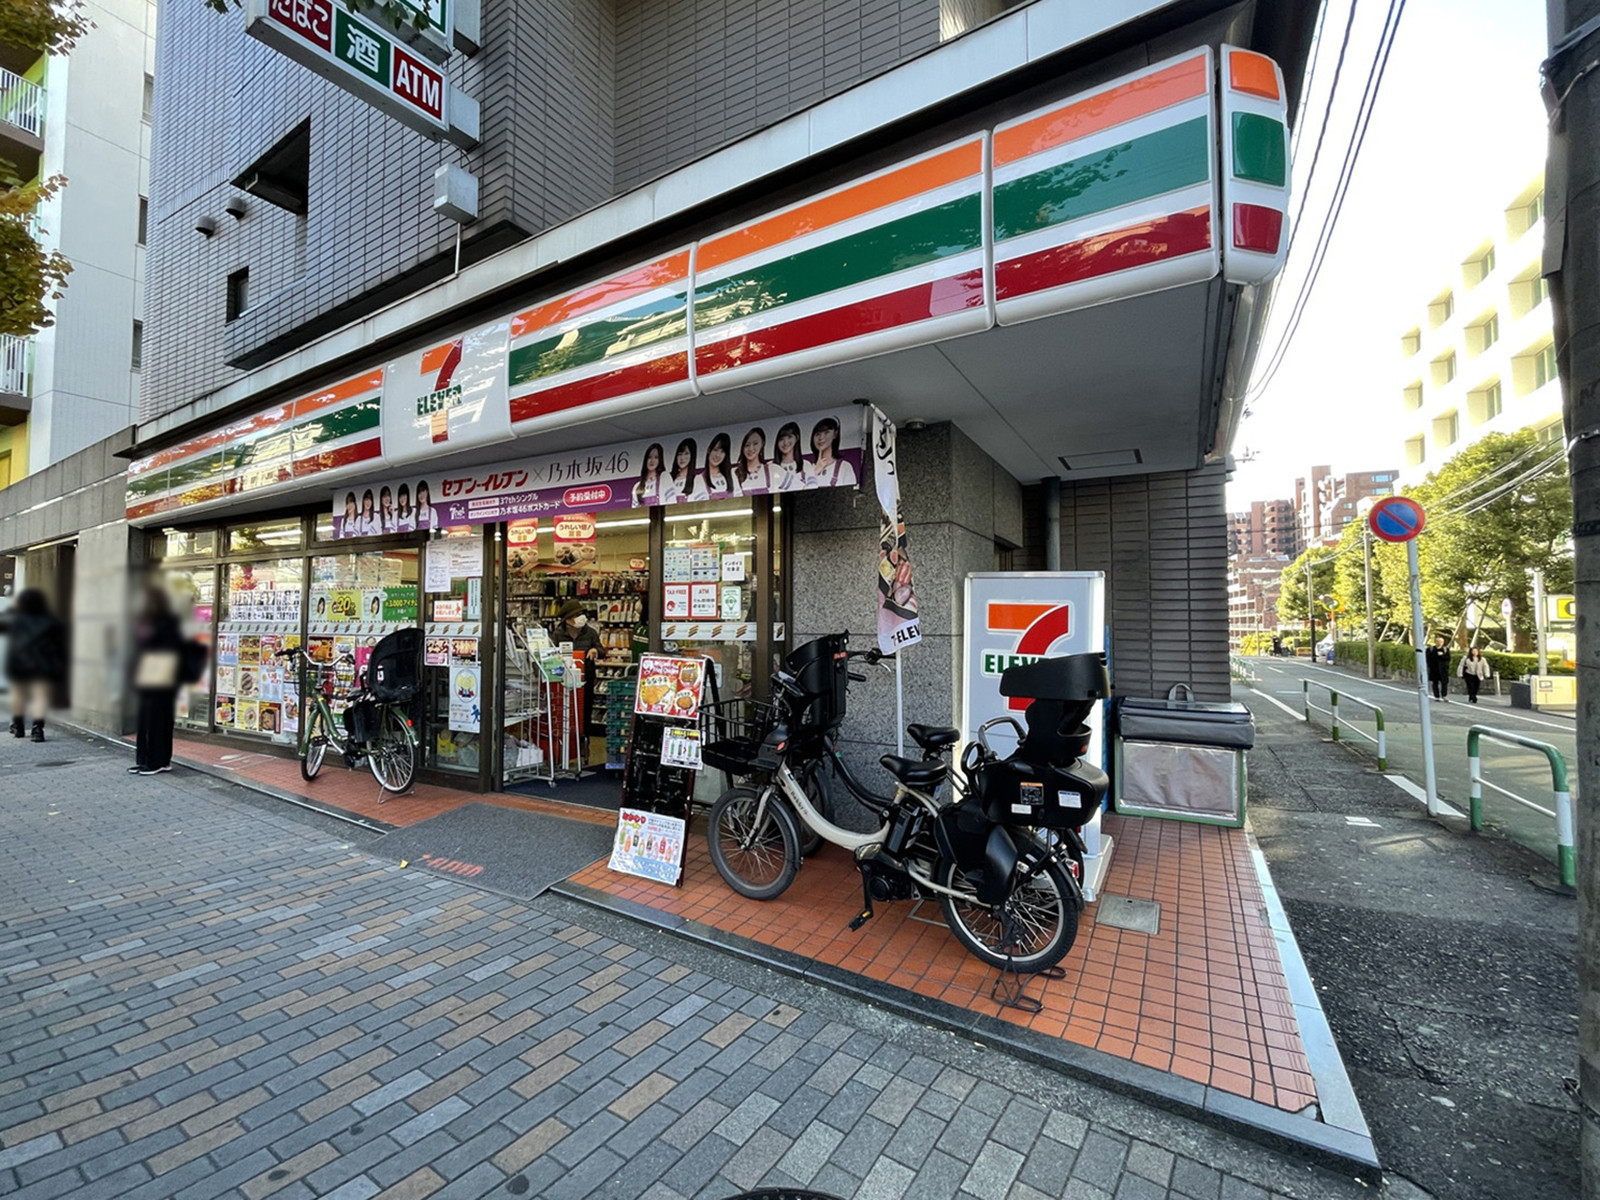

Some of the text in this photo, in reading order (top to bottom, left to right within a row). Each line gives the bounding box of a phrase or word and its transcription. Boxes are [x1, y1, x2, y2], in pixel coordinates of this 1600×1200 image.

[347, 24, 380, 73] 酒
[396, 59, 440, 111] ATM
[547, 451, 631, 483] 乃木坂46
[500, 492, 539, 506] 37thシングル
[569, 489, 607, 503] 予約受付中
[500, 501, 560, 516] 乃木坂46ポストカード
